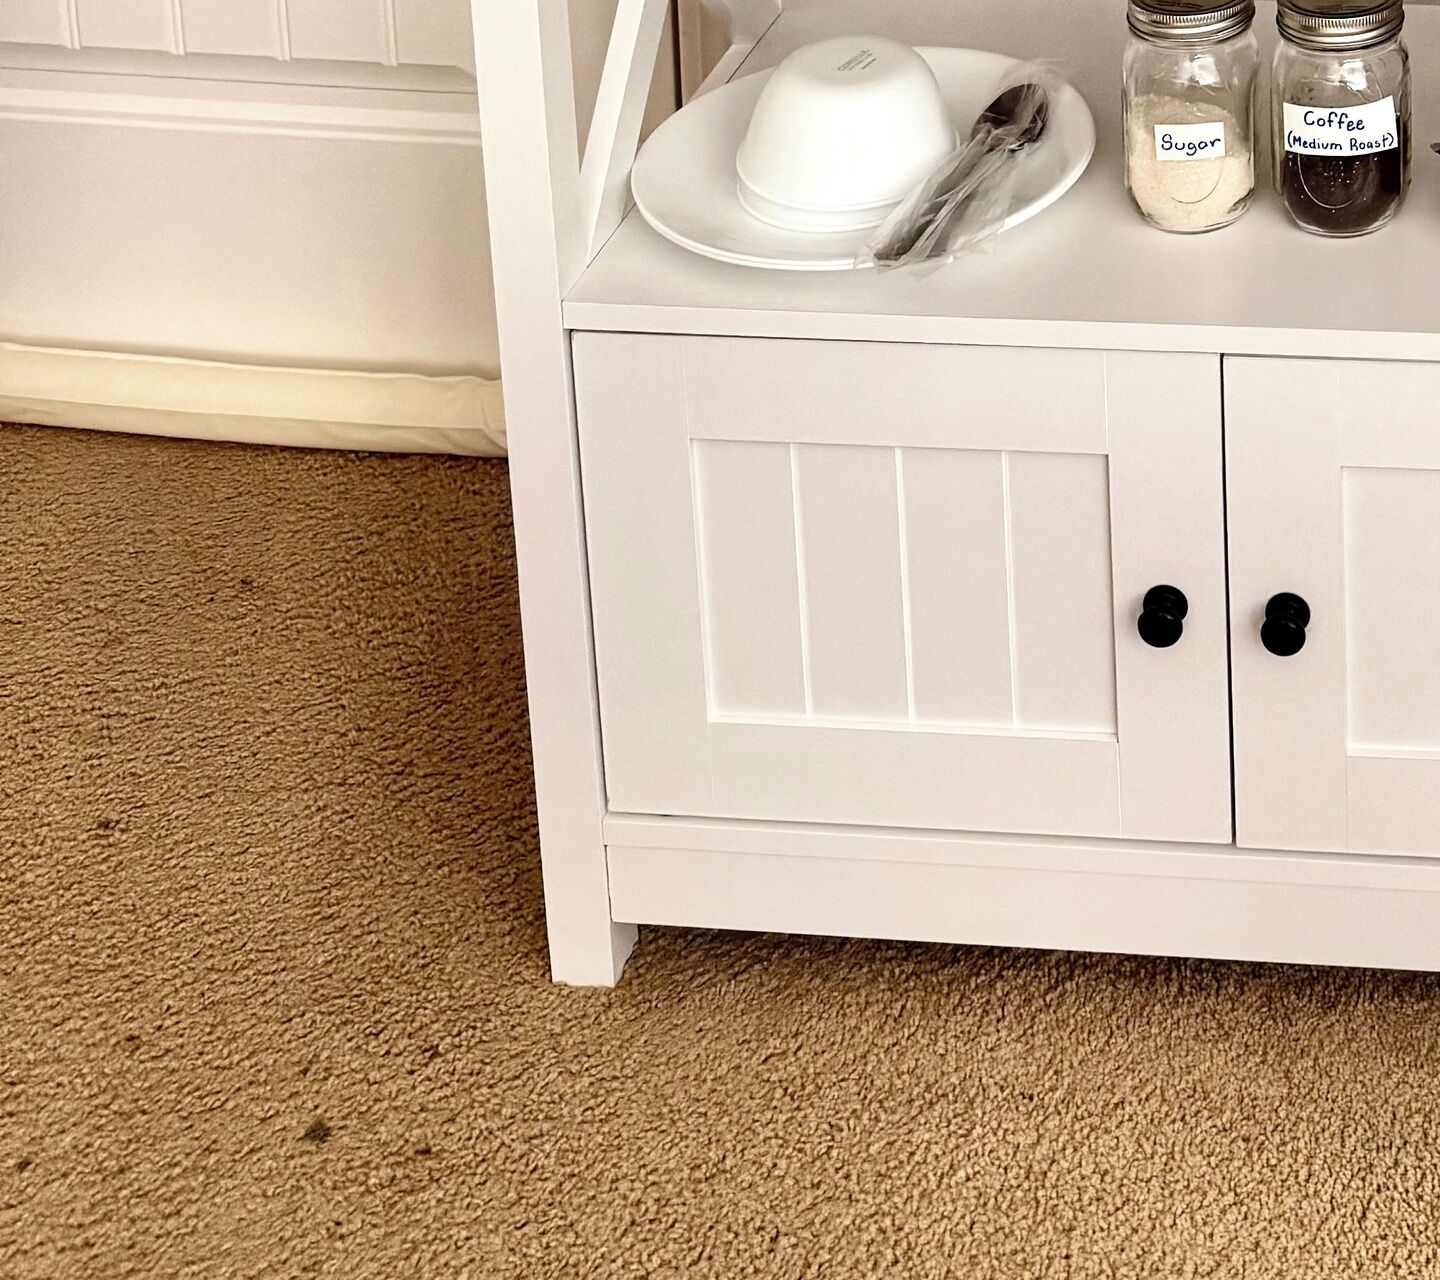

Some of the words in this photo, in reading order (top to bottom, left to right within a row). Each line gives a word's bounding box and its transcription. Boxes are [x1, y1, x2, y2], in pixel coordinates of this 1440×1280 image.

[1303, 110, 1366, 132] Coffee
[1161, 134, 1222, 157] Sugar
[1287, 131, 1343, 152] (Medium
[1349, 132, 1395, 152] Roast)
